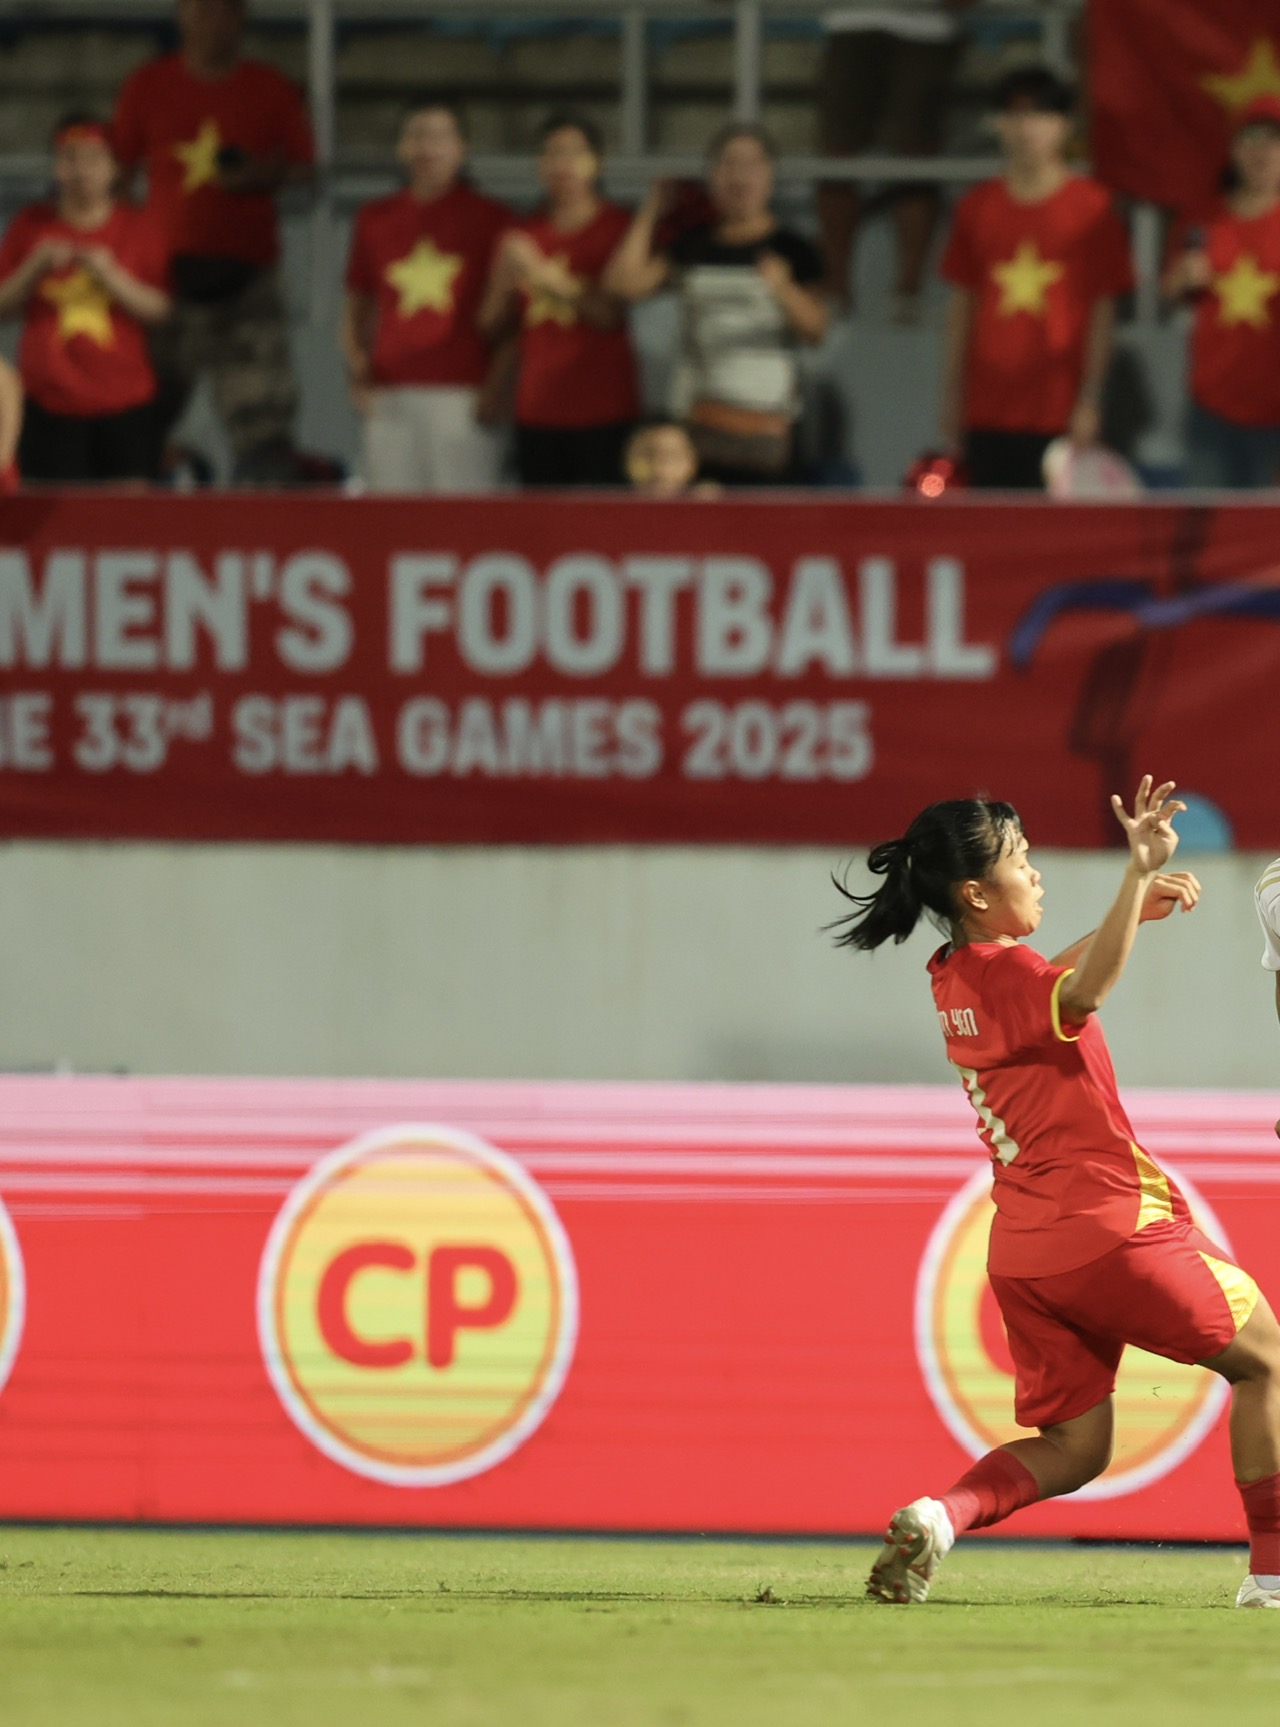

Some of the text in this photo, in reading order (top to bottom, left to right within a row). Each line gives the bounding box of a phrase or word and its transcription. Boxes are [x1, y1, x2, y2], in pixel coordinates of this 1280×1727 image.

[391, 555, 992, 675] FOOTBALL
[0, 695, 52, 770] E
[235, 696, 377, 775] SEA
[401, 699, 662, 780] GAMES
[683, 702, 872, 780] 2025
[316, 1240, 521, 1371] CP
